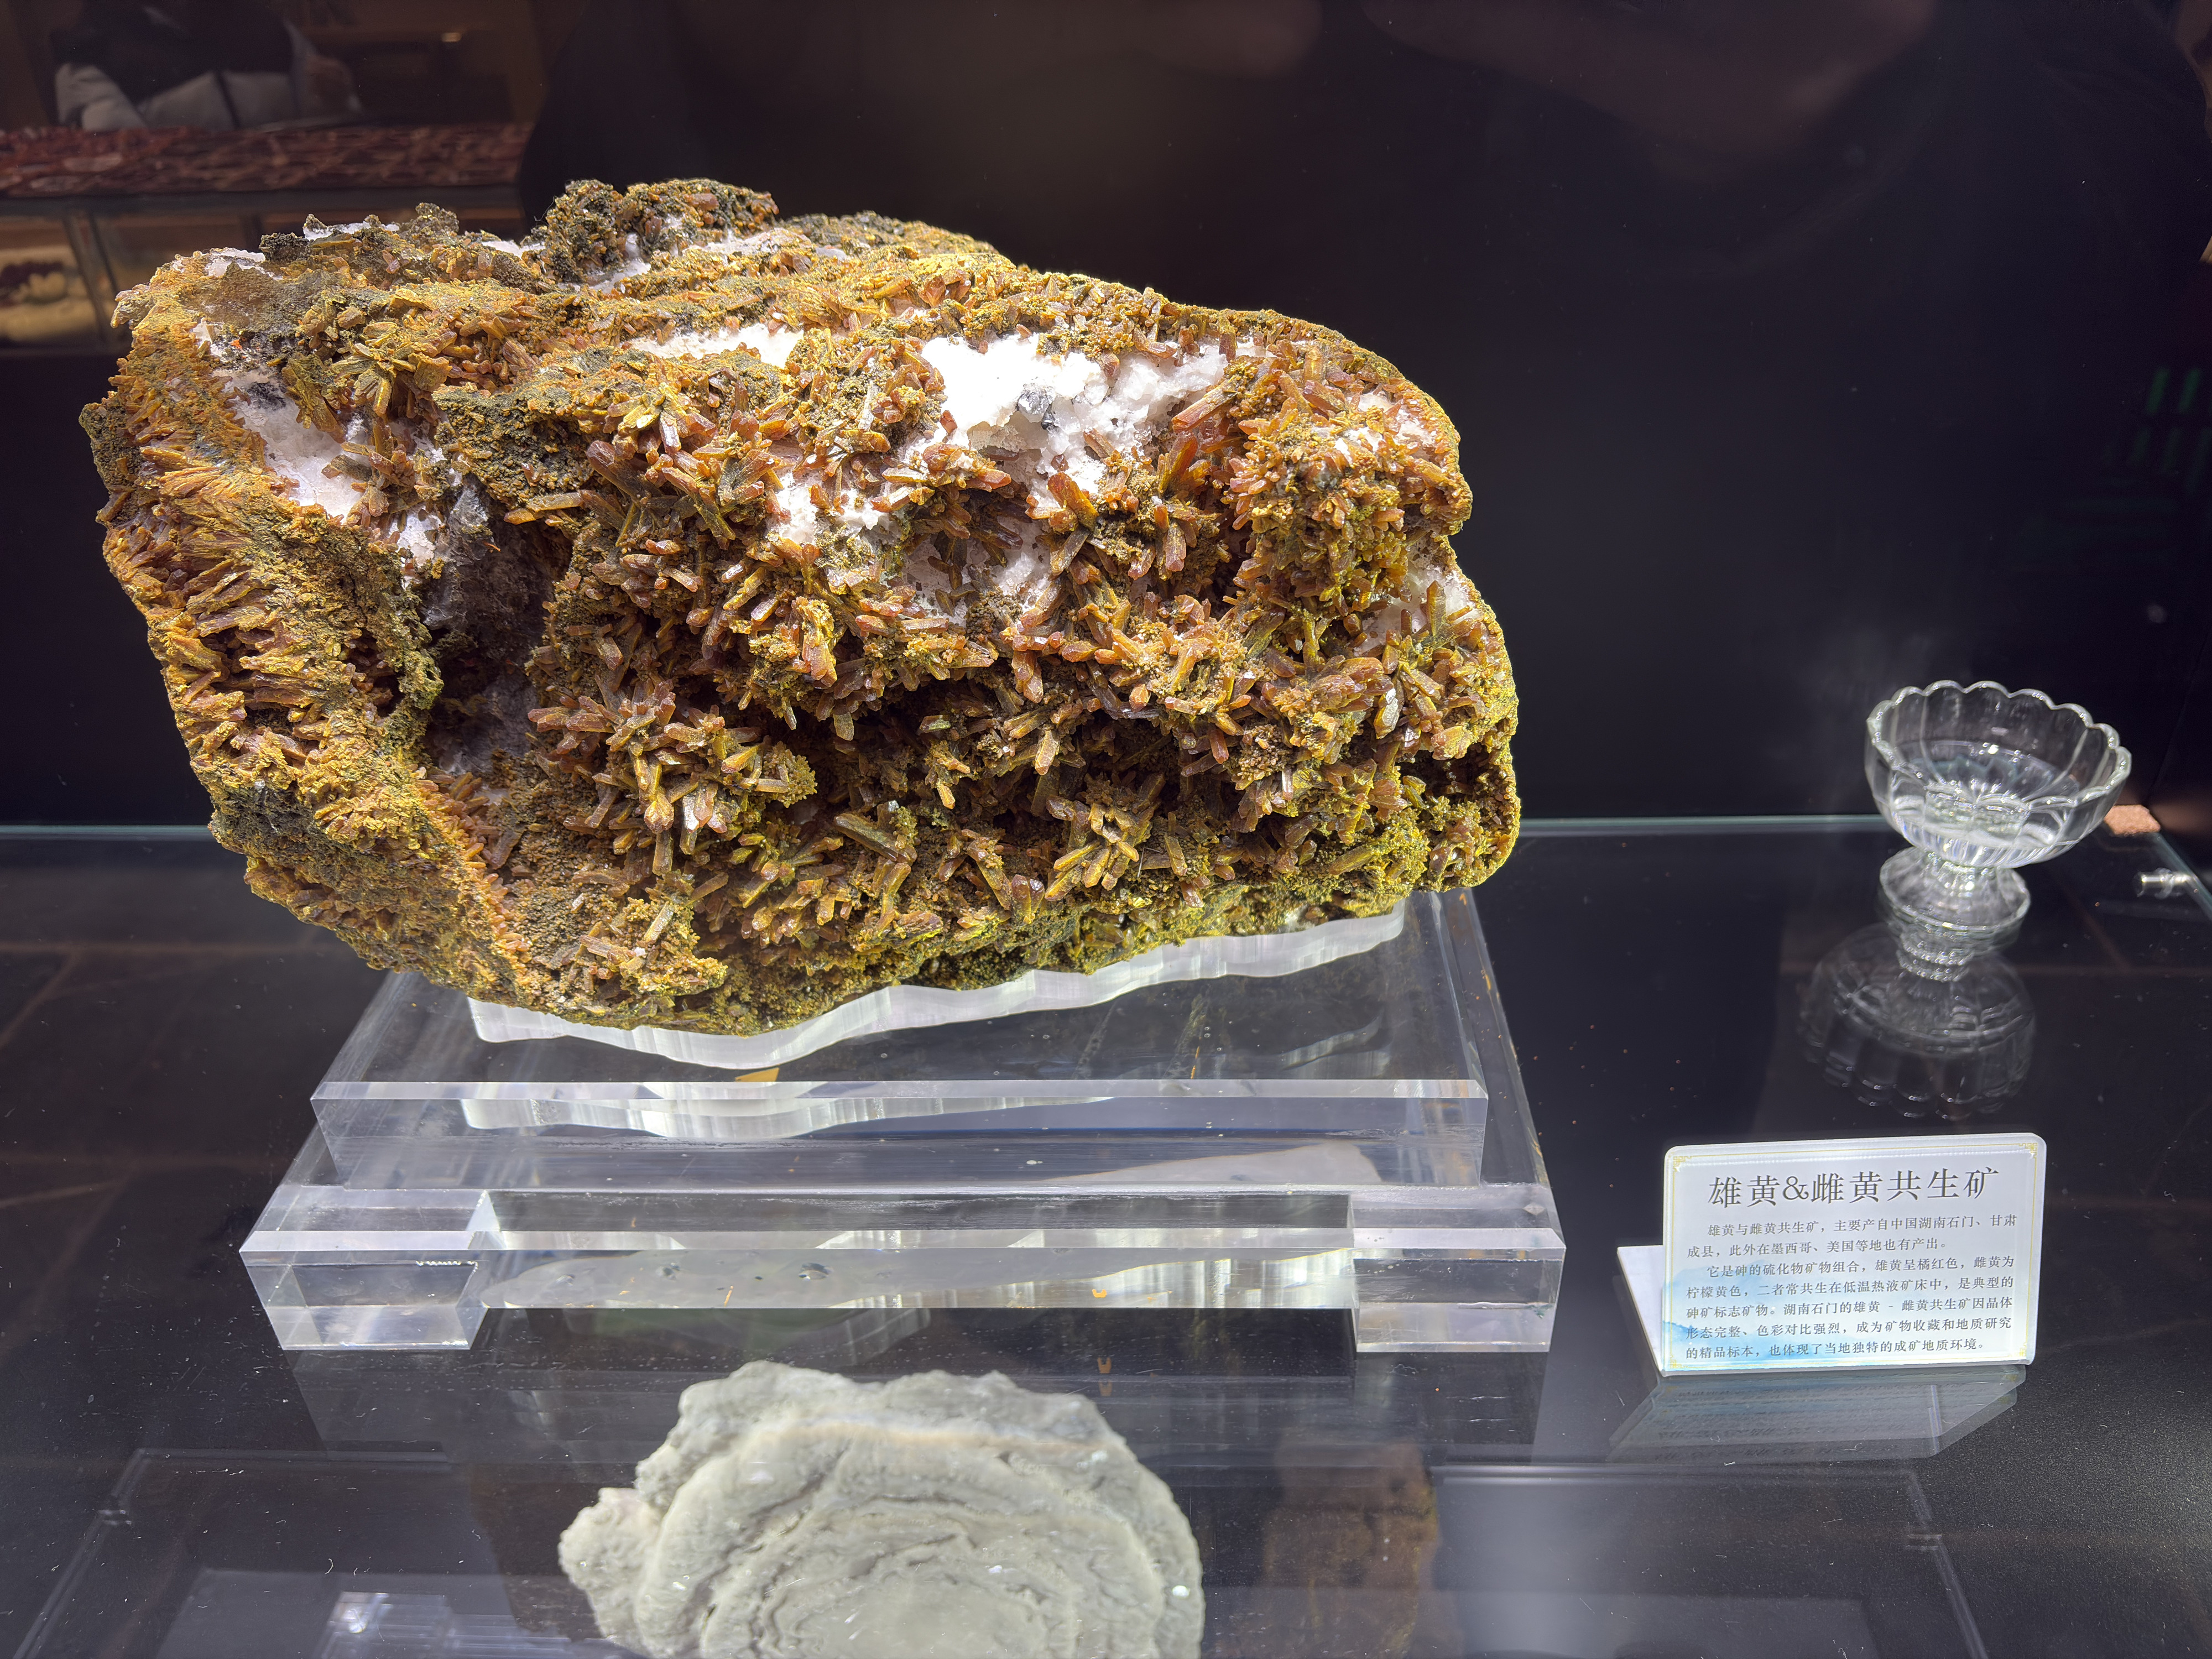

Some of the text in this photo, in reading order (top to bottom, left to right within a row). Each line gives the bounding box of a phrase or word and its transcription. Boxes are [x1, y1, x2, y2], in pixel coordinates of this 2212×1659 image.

[1708, 1167, 2000, 1208] 雄黄&雌黄共生矿
[1707, 1214, 2017, 1237] 雄黄与雌黄共生矿，主要产自中国湖南石门、甘肃
[1687, 1238, 1946, 1259] 成县，此外在墨西哥、美国等地也有产出。
[1707, 1255, 2014, 1277] 它是砷的硫化物矿物组合，雄黄呈橘红色，雌黄为
[1686, 1276, 2013, 1299] 柠檬黄色，二者常共生在低温热液矿床中，是典型的
[1686, 1338, 1984, 1359] 的精品标本，也体现了当地独特的成矿地质环境。
